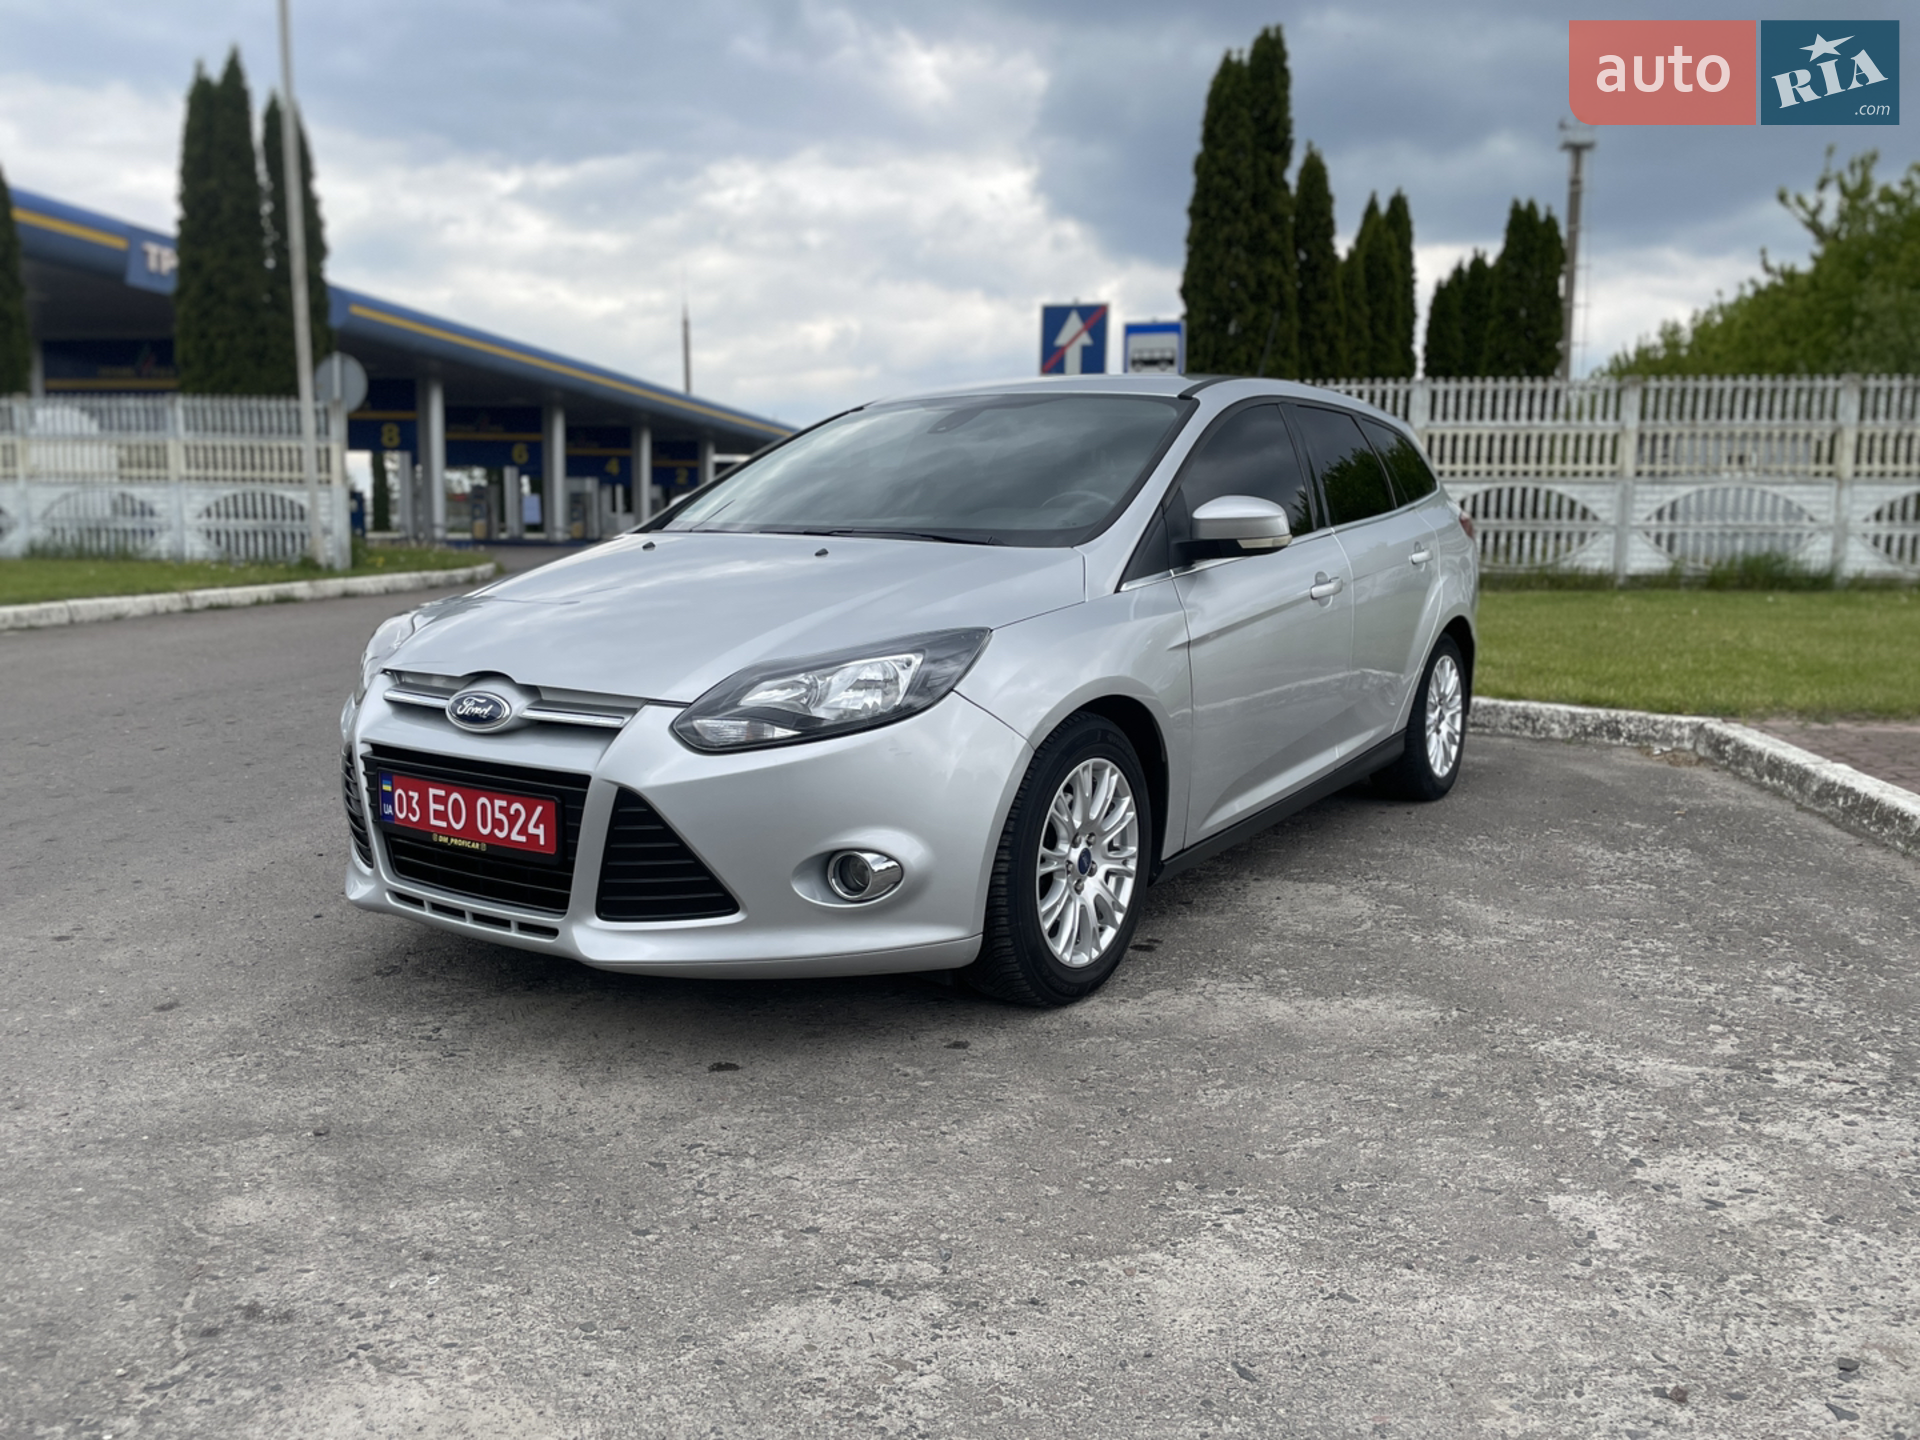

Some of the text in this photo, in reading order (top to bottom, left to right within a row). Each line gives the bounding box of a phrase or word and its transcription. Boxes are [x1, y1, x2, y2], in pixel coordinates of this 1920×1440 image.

[381, 422, 401, 448] 8
[512, 443, 529, 465] 6
[604, 456, 621, 476] 4
[675, 467, 689, 485] 2
[456, 696, 493, 719] Ford
[383, 803, 393, 816] UA
[394, 787, 545, 846] 03 EO 0524
